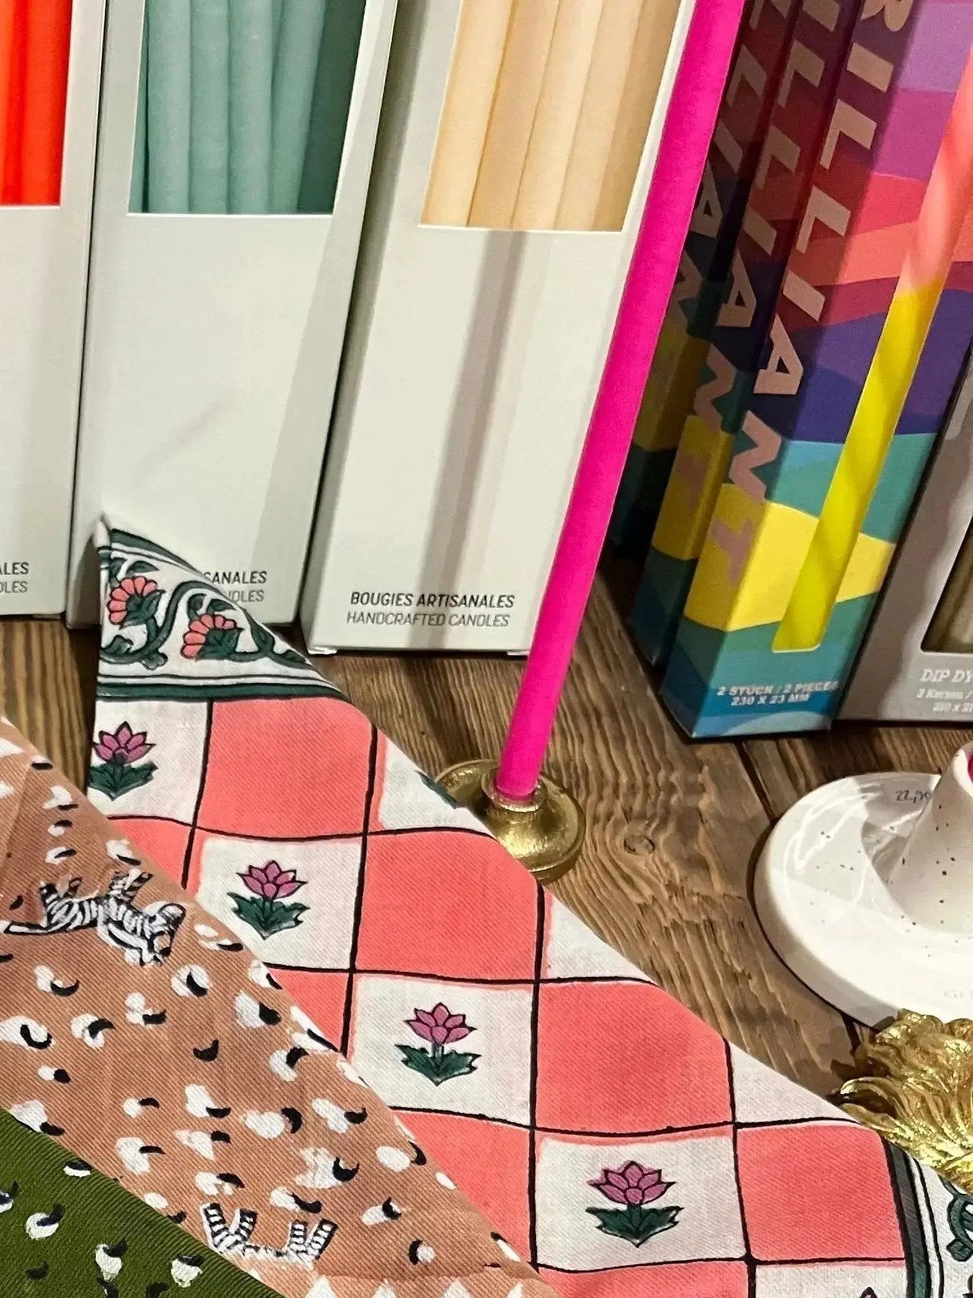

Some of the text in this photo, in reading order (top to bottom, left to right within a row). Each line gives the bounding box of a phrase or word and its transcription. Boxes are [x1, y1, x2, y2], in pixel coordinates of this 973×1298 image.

[350, 591, 515, 609] BOUGIES ARTISANALES
[346, 612, 511, 628] HANDCRAFTED CANDLES
[717, 686, 727, 696] 2
